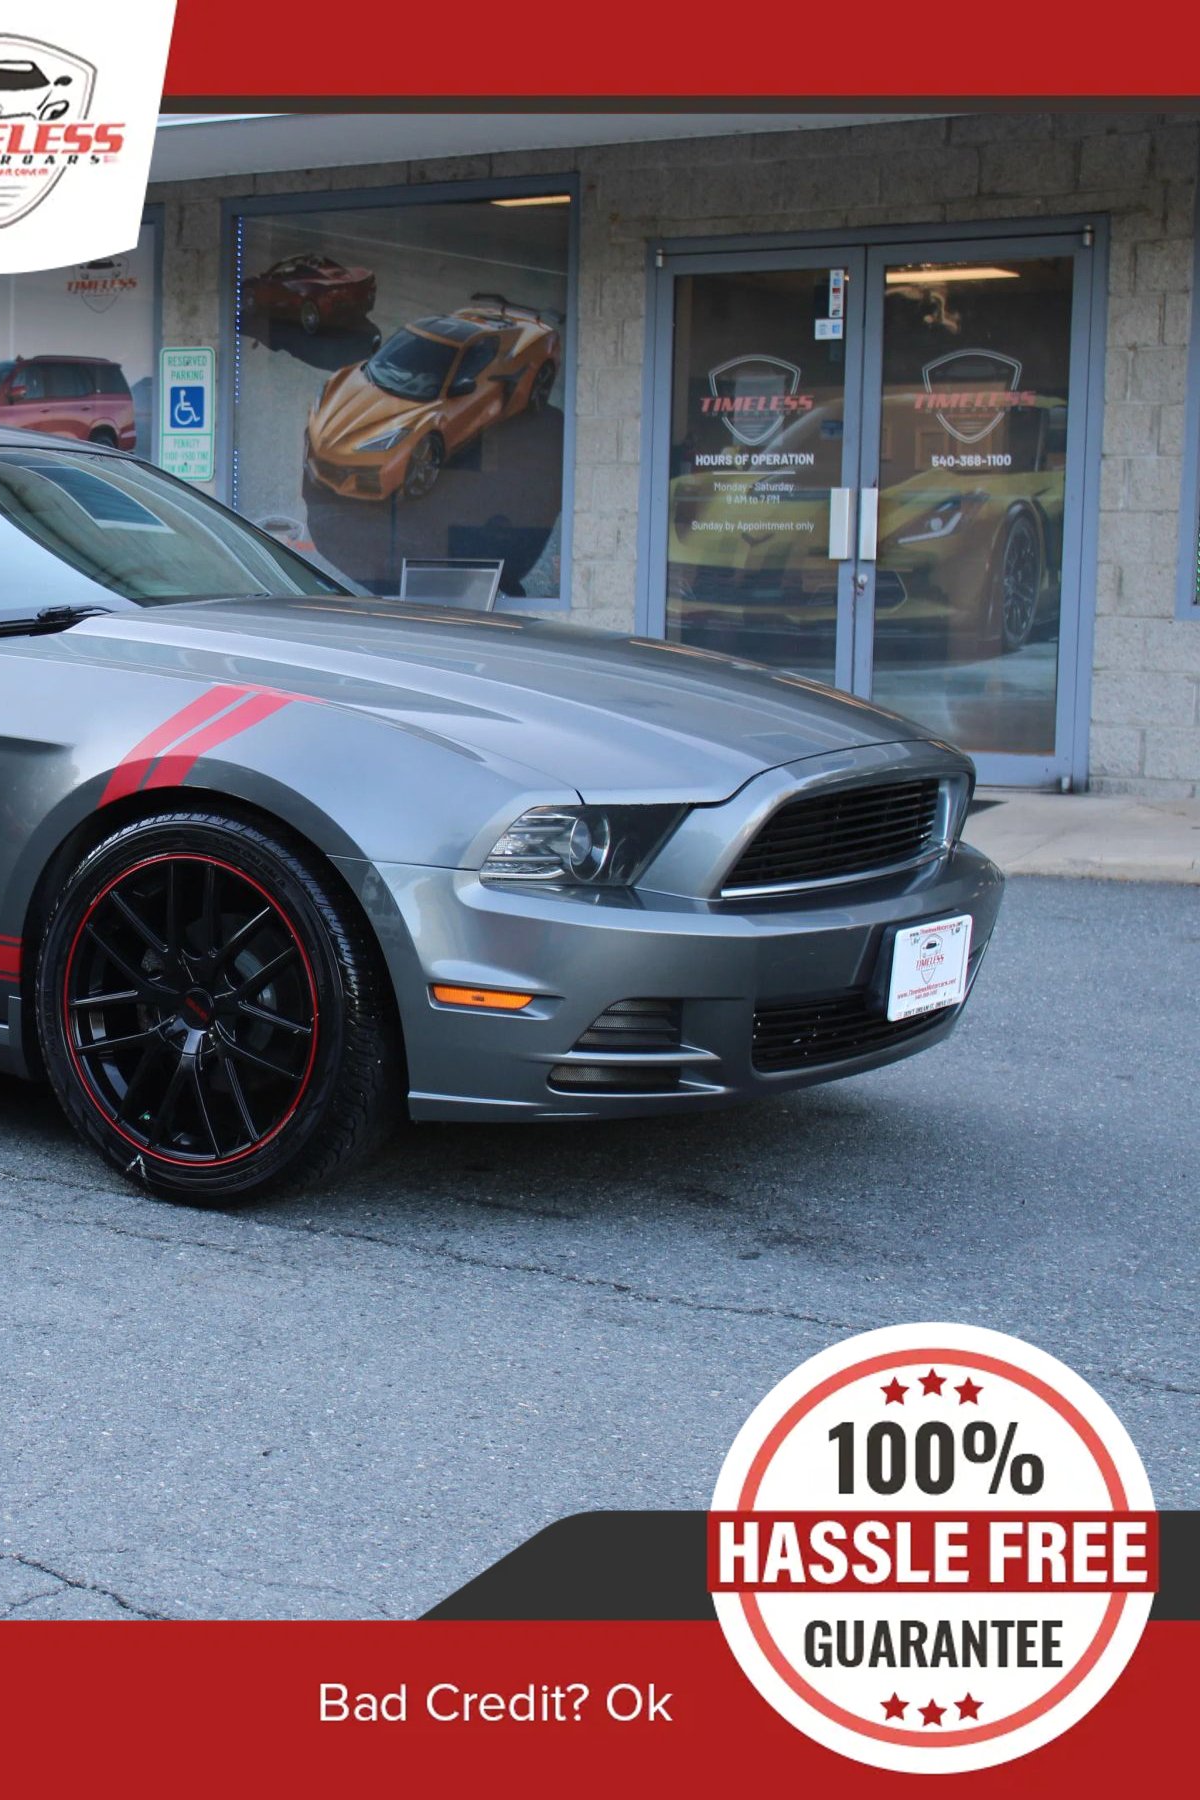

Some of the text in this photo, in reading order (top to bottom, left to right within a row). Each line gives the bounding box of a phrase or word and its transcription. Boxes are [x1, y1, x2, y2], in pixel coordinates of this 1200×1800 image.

[167, 355, 208, 367] RESERVED
[171, 370, 205, 380] PARKING
[700, 395, 815, 413] TIMELESS
[913, 391, 1037, 409] TIMELESS
[695, 452, 815, 467] HOURS OF OPERATION
[931, 454, 1012, 467] 540-368-1100
[713, 482, 747, 495] Monday
[755, 482, 794, 494] Saturday
[691, 521, 815, 533] Sunday by Appointment only
[915, 954, 945, 971] TIMELESS
